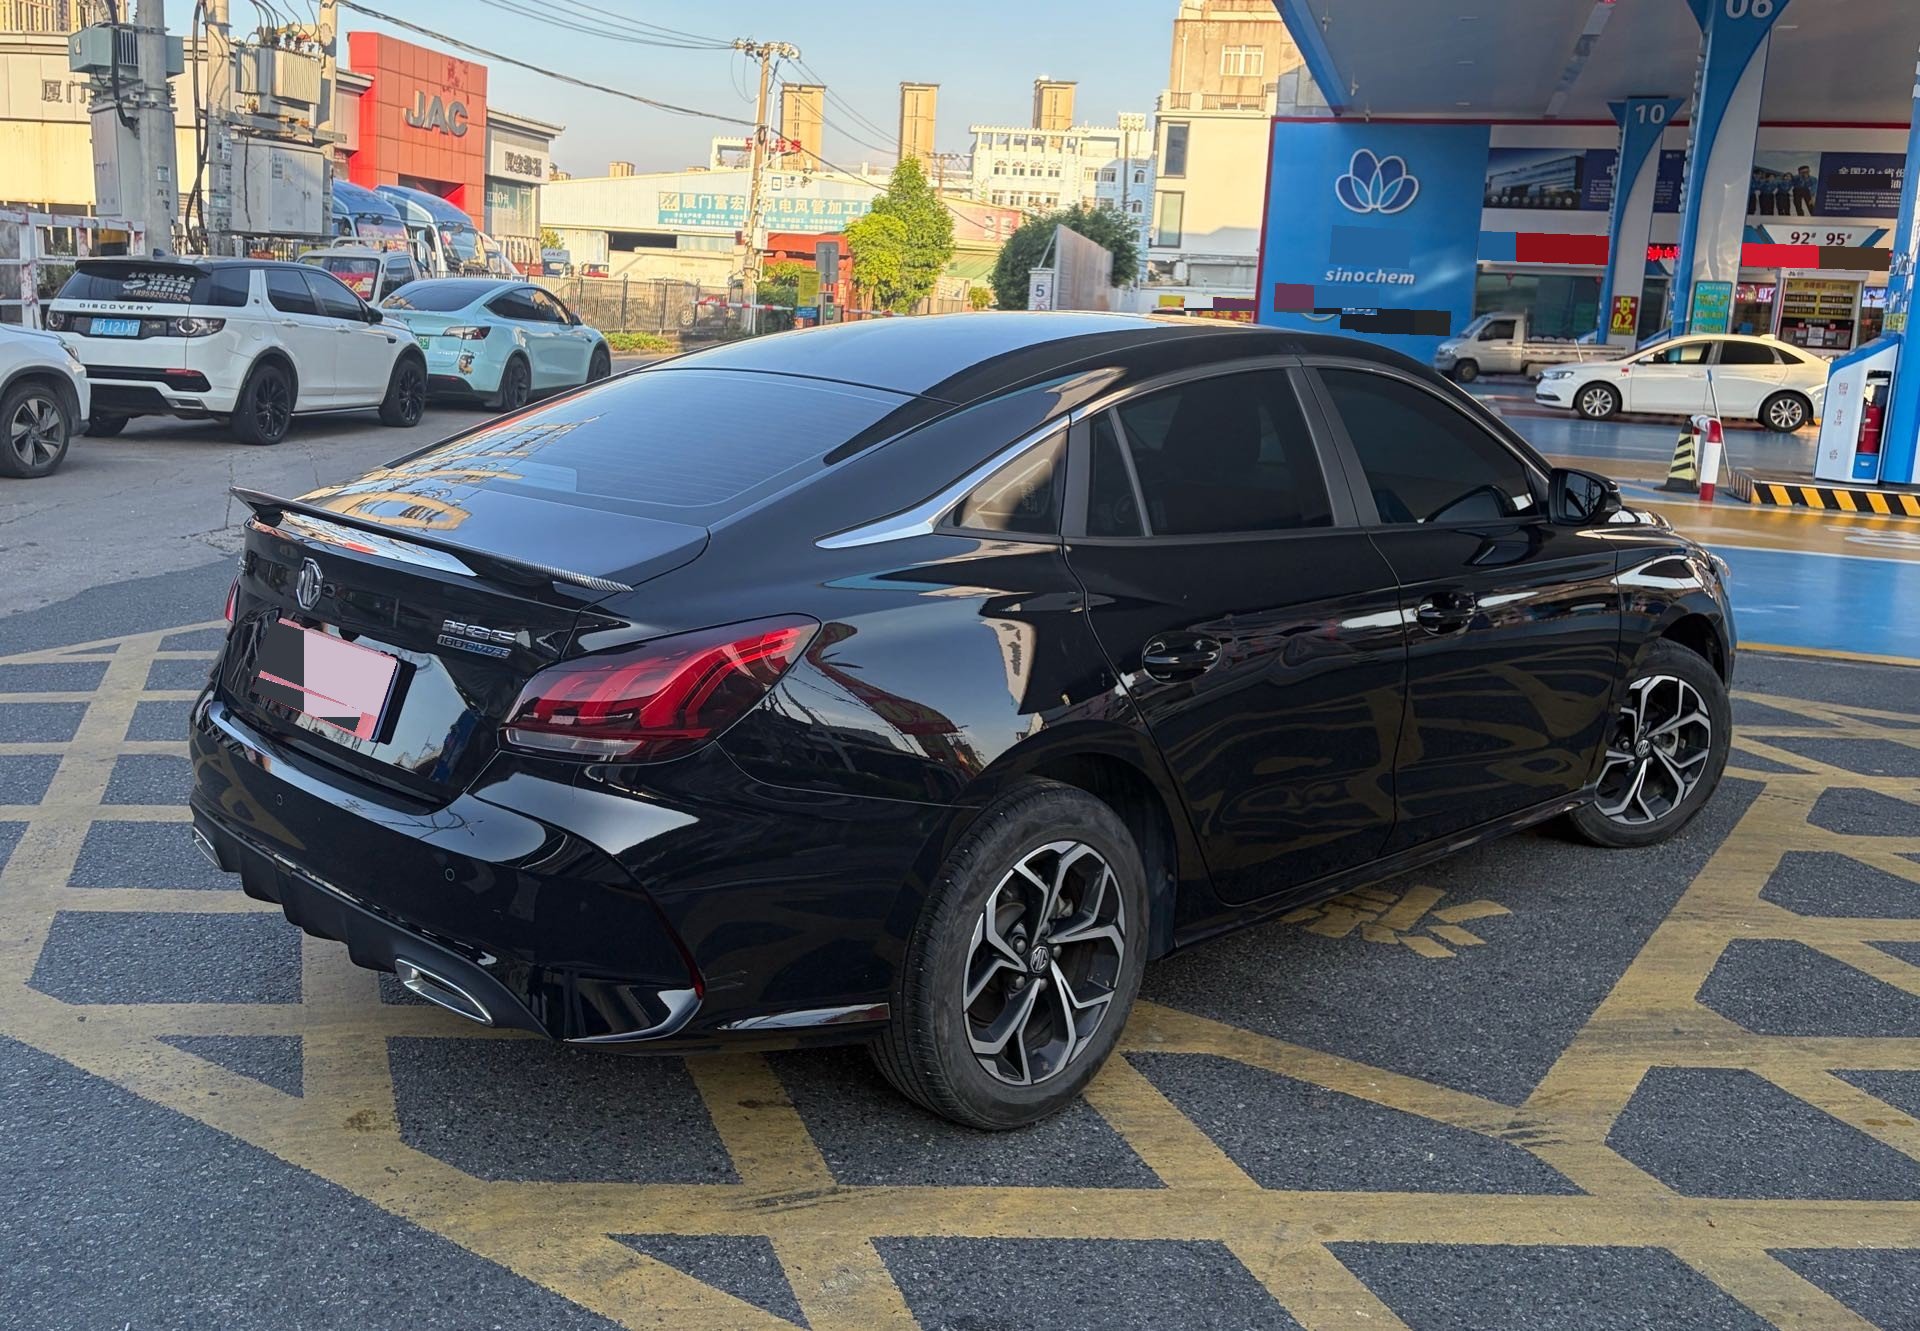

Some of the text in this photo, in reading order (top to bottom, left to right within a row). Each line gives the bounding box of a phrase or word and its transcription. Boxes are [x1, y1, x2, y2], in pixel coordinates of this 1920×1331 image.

[402, 89, 469, 138] JAC
[1635, 103, 1665, 124] 10
[1325, 267, 1415, 285] sinochem
[1035, 284, 1045, 297] 5
[79, 302, 153, 311] DISCOVERY
[1031, 947, 1048, 971] MG
